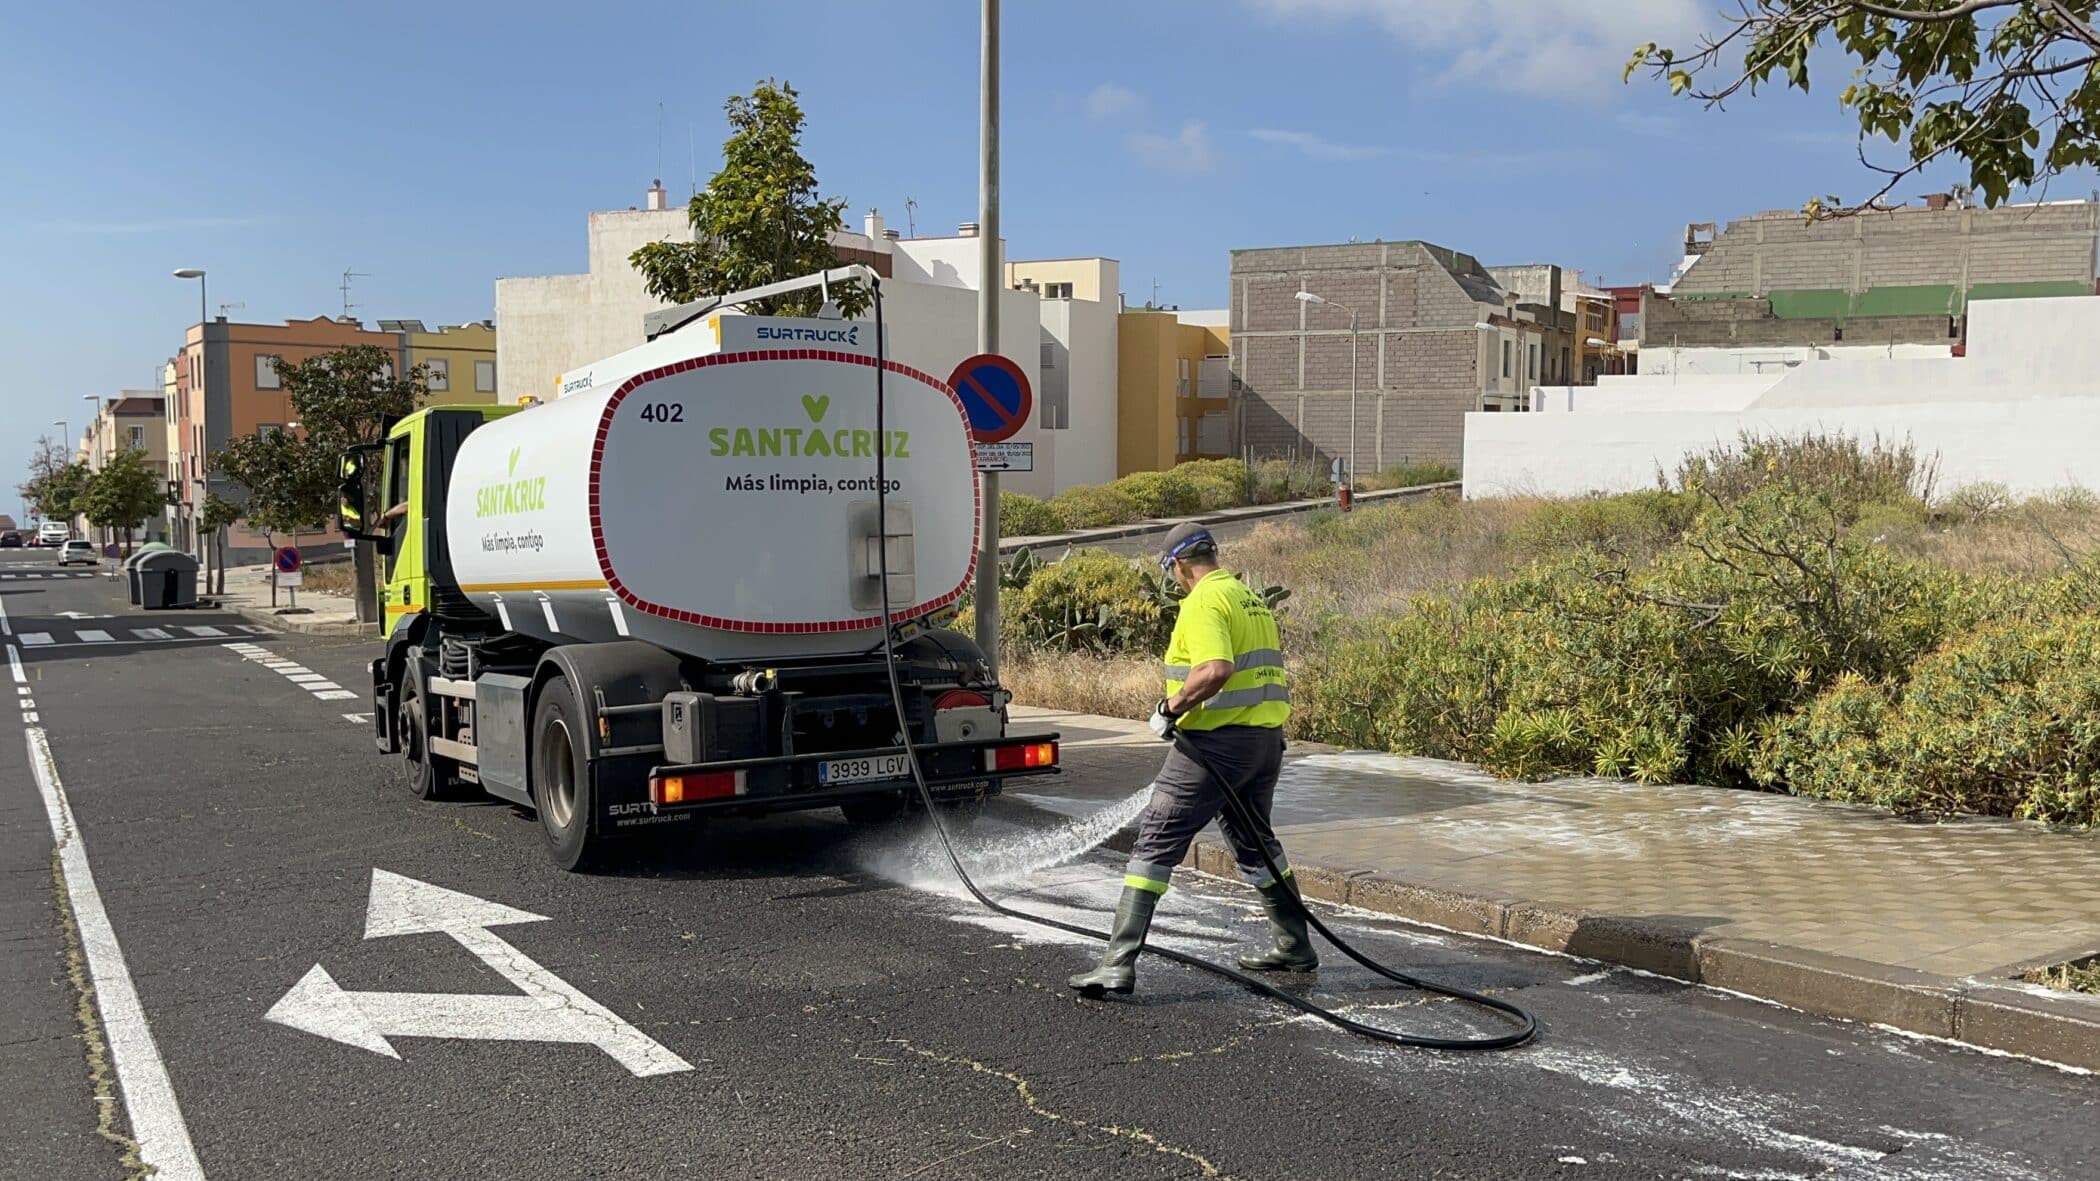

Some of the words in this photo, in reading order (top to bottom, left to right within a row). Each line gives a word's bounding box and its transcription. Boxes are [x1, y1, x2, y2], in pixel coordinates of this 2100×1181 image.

[757, 327, 847, 342] SURTRUCK
[564, 377, 590, 393] SURTRUCK
[640, 403, 684, 423] 402
[708, 427, 911, 458] SANTACRUZ
[726, 474, 765, 490] Más
[769, 474, 833, 494] limpia,
[477, 476, 545, 518] SANTACRUZ
[482, 533, 494, 552] Más
[494, 531, 517, 554] limpia,
[517, 528, 544, 552] contigo
[831, 760, 869, 779] 3939
[876, 756, 905, 774] LGV
[609, 801, 657, 815] SURT
[616, 813, 690, 827] www.surtruck.com
